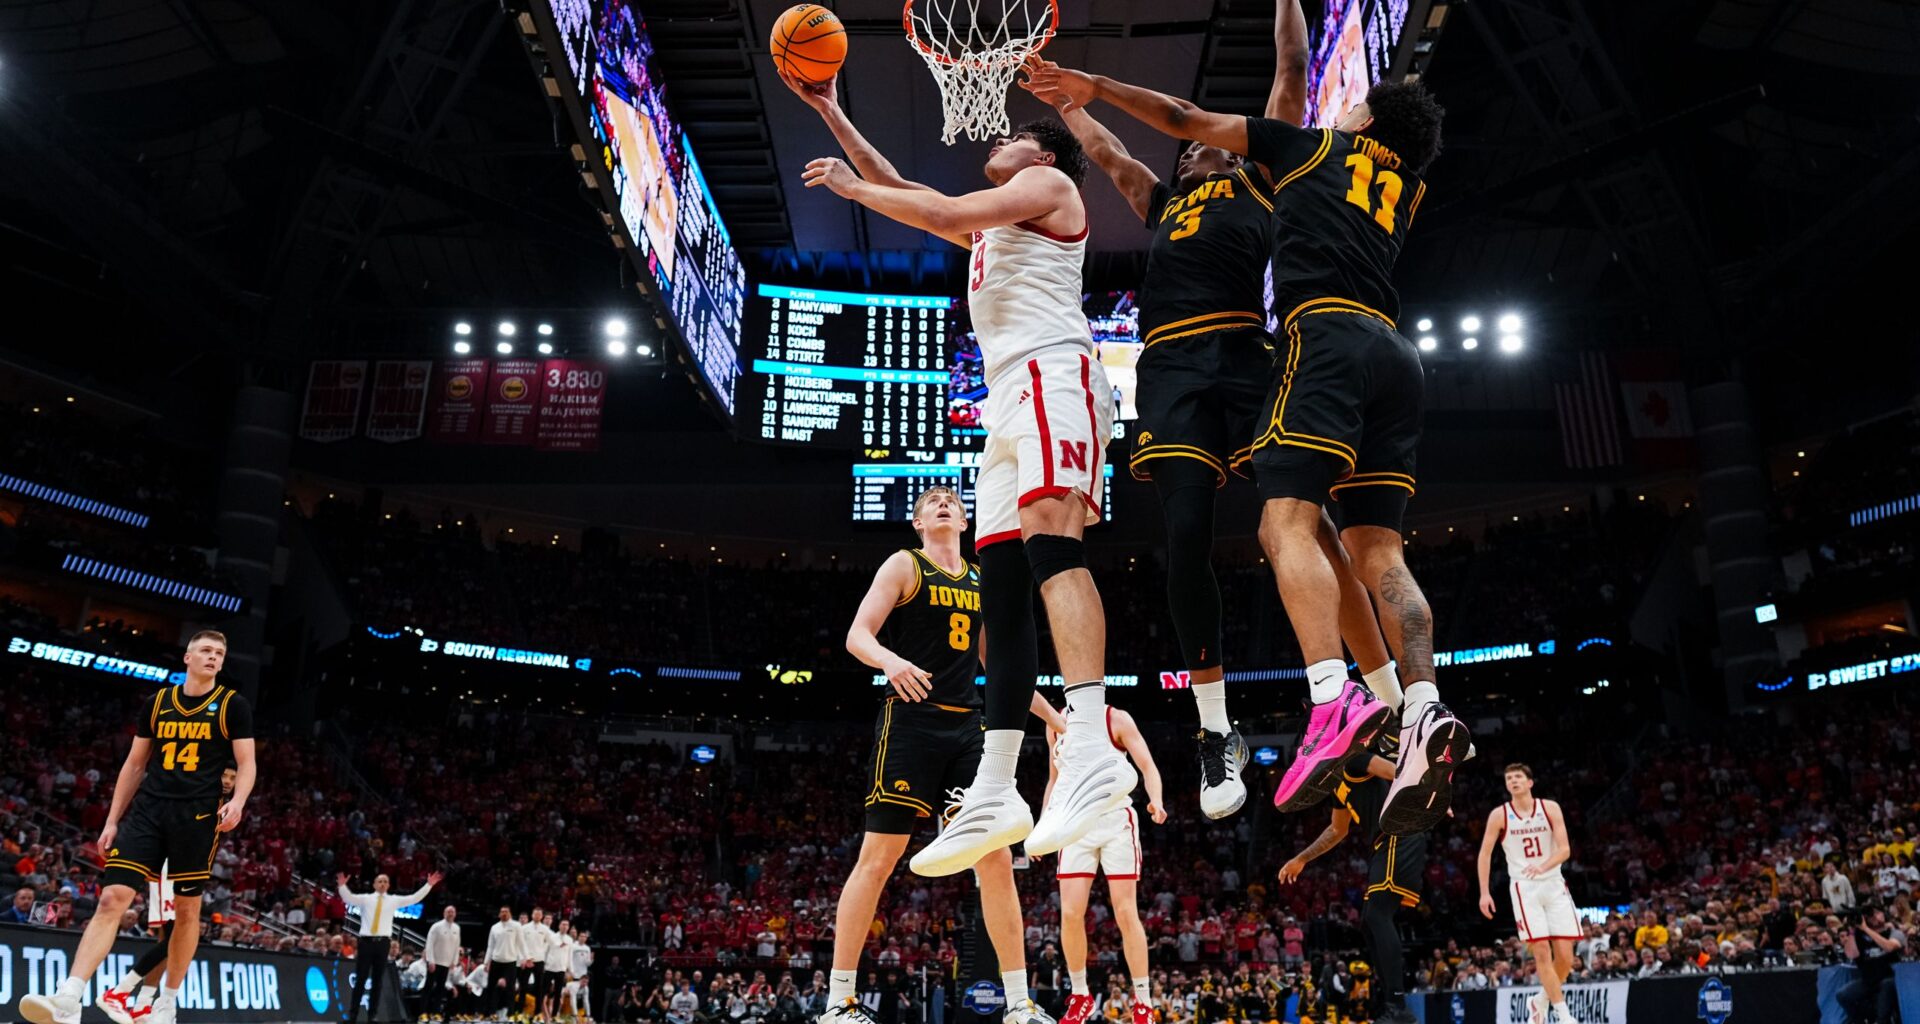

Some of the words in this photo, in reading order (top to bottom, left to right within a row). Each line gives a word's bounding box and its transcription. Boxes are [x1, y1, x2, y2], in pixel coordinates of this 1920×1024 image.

[1353, 134, 1401, 170] COMBS
[1160, 179, 1235, 224] IOWA
[1345, 153, 1403, 235] 11
[1169, 204, 1205, 241] 3
[971, 242, 986, 292] 9
[789, 299, 843, 314] MANYAWU
[788, 311, 824, 325] BANKS
[787, 324, 817, 337] KOCH
[768, 335, 780, 347] 11
[787, 337, 826, 351] COMBS
[766, 347, 780, 359] 14
[786, 349, 825, 364] STIRTZ
[864, 355, 878, 367] 13
[547, 368, 603, 391] 3,830
[785, 375, 833, 390] HOIBERG
[763, 399, 777, 412] 10
[783, 401, 840, 417] LAWRENCE
[762, 413, 776, 425] 21
[782, 414, 839, 430] SANDFORT
[862, 420, 875, 432] 11
[762, 426, 775, 439] 51
[782, 427, 813, 442] MAST
[1059, 440, 1087, 473] N
[949, 612, 971, 651] 8
[31, 642, 95, 667] SWEET
[94, 655, 169, 682] SIXTEEN
[443, 641, 496, 659] SOUTH
[495, 648, 570, 668] REGIONAL
[1453, 643, 1532, 664] REGIONAL
[1829, 660, 1888, 685] SWEET
[157, 721, 211, 739] IOWA
[161, 742, 199, 771] 14
[1510, 826, 1547, 835] NEBRASKA
[1522, 836, 1542, 858] 21
[22, 946, 68, 998] TO
[219, 961, 281, 1010] FOUR
